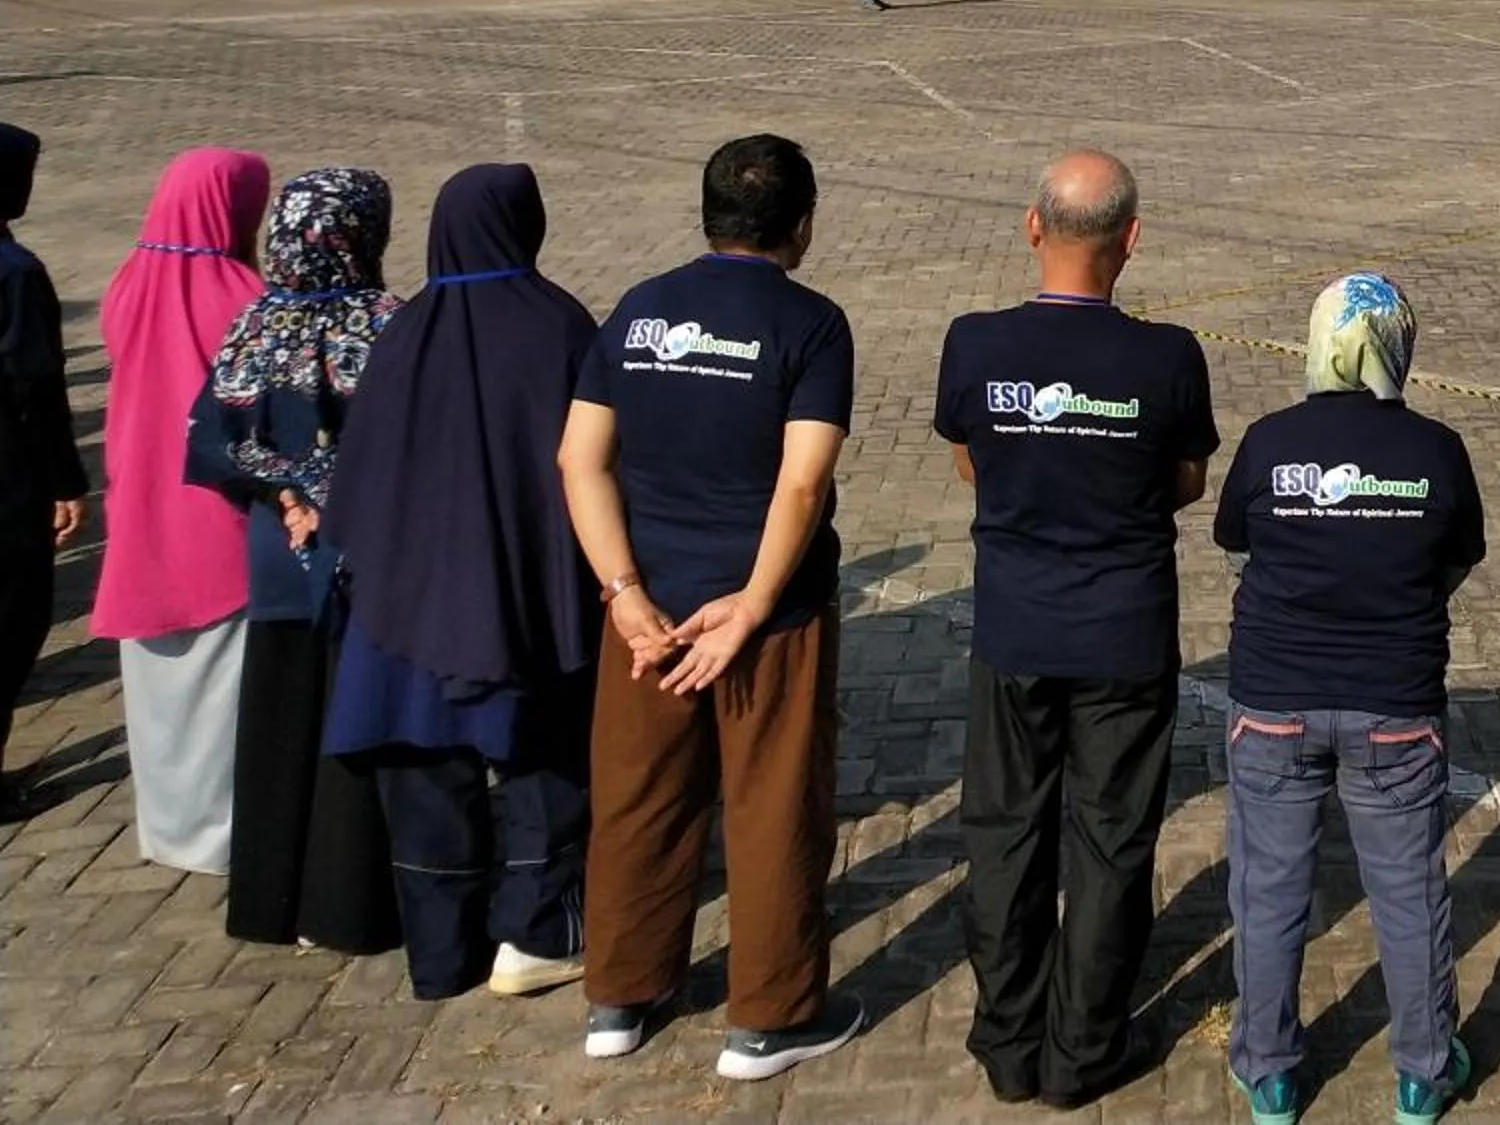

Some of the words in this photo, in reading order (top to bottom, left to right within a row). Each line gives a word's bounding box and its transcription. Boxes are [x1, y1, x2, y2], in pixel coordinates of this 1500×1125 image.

[625, 319, 668, 352] ESQ
[987, 381, 1035, 415] ESQ
[1272, 462, 1321, 496] ESQ
